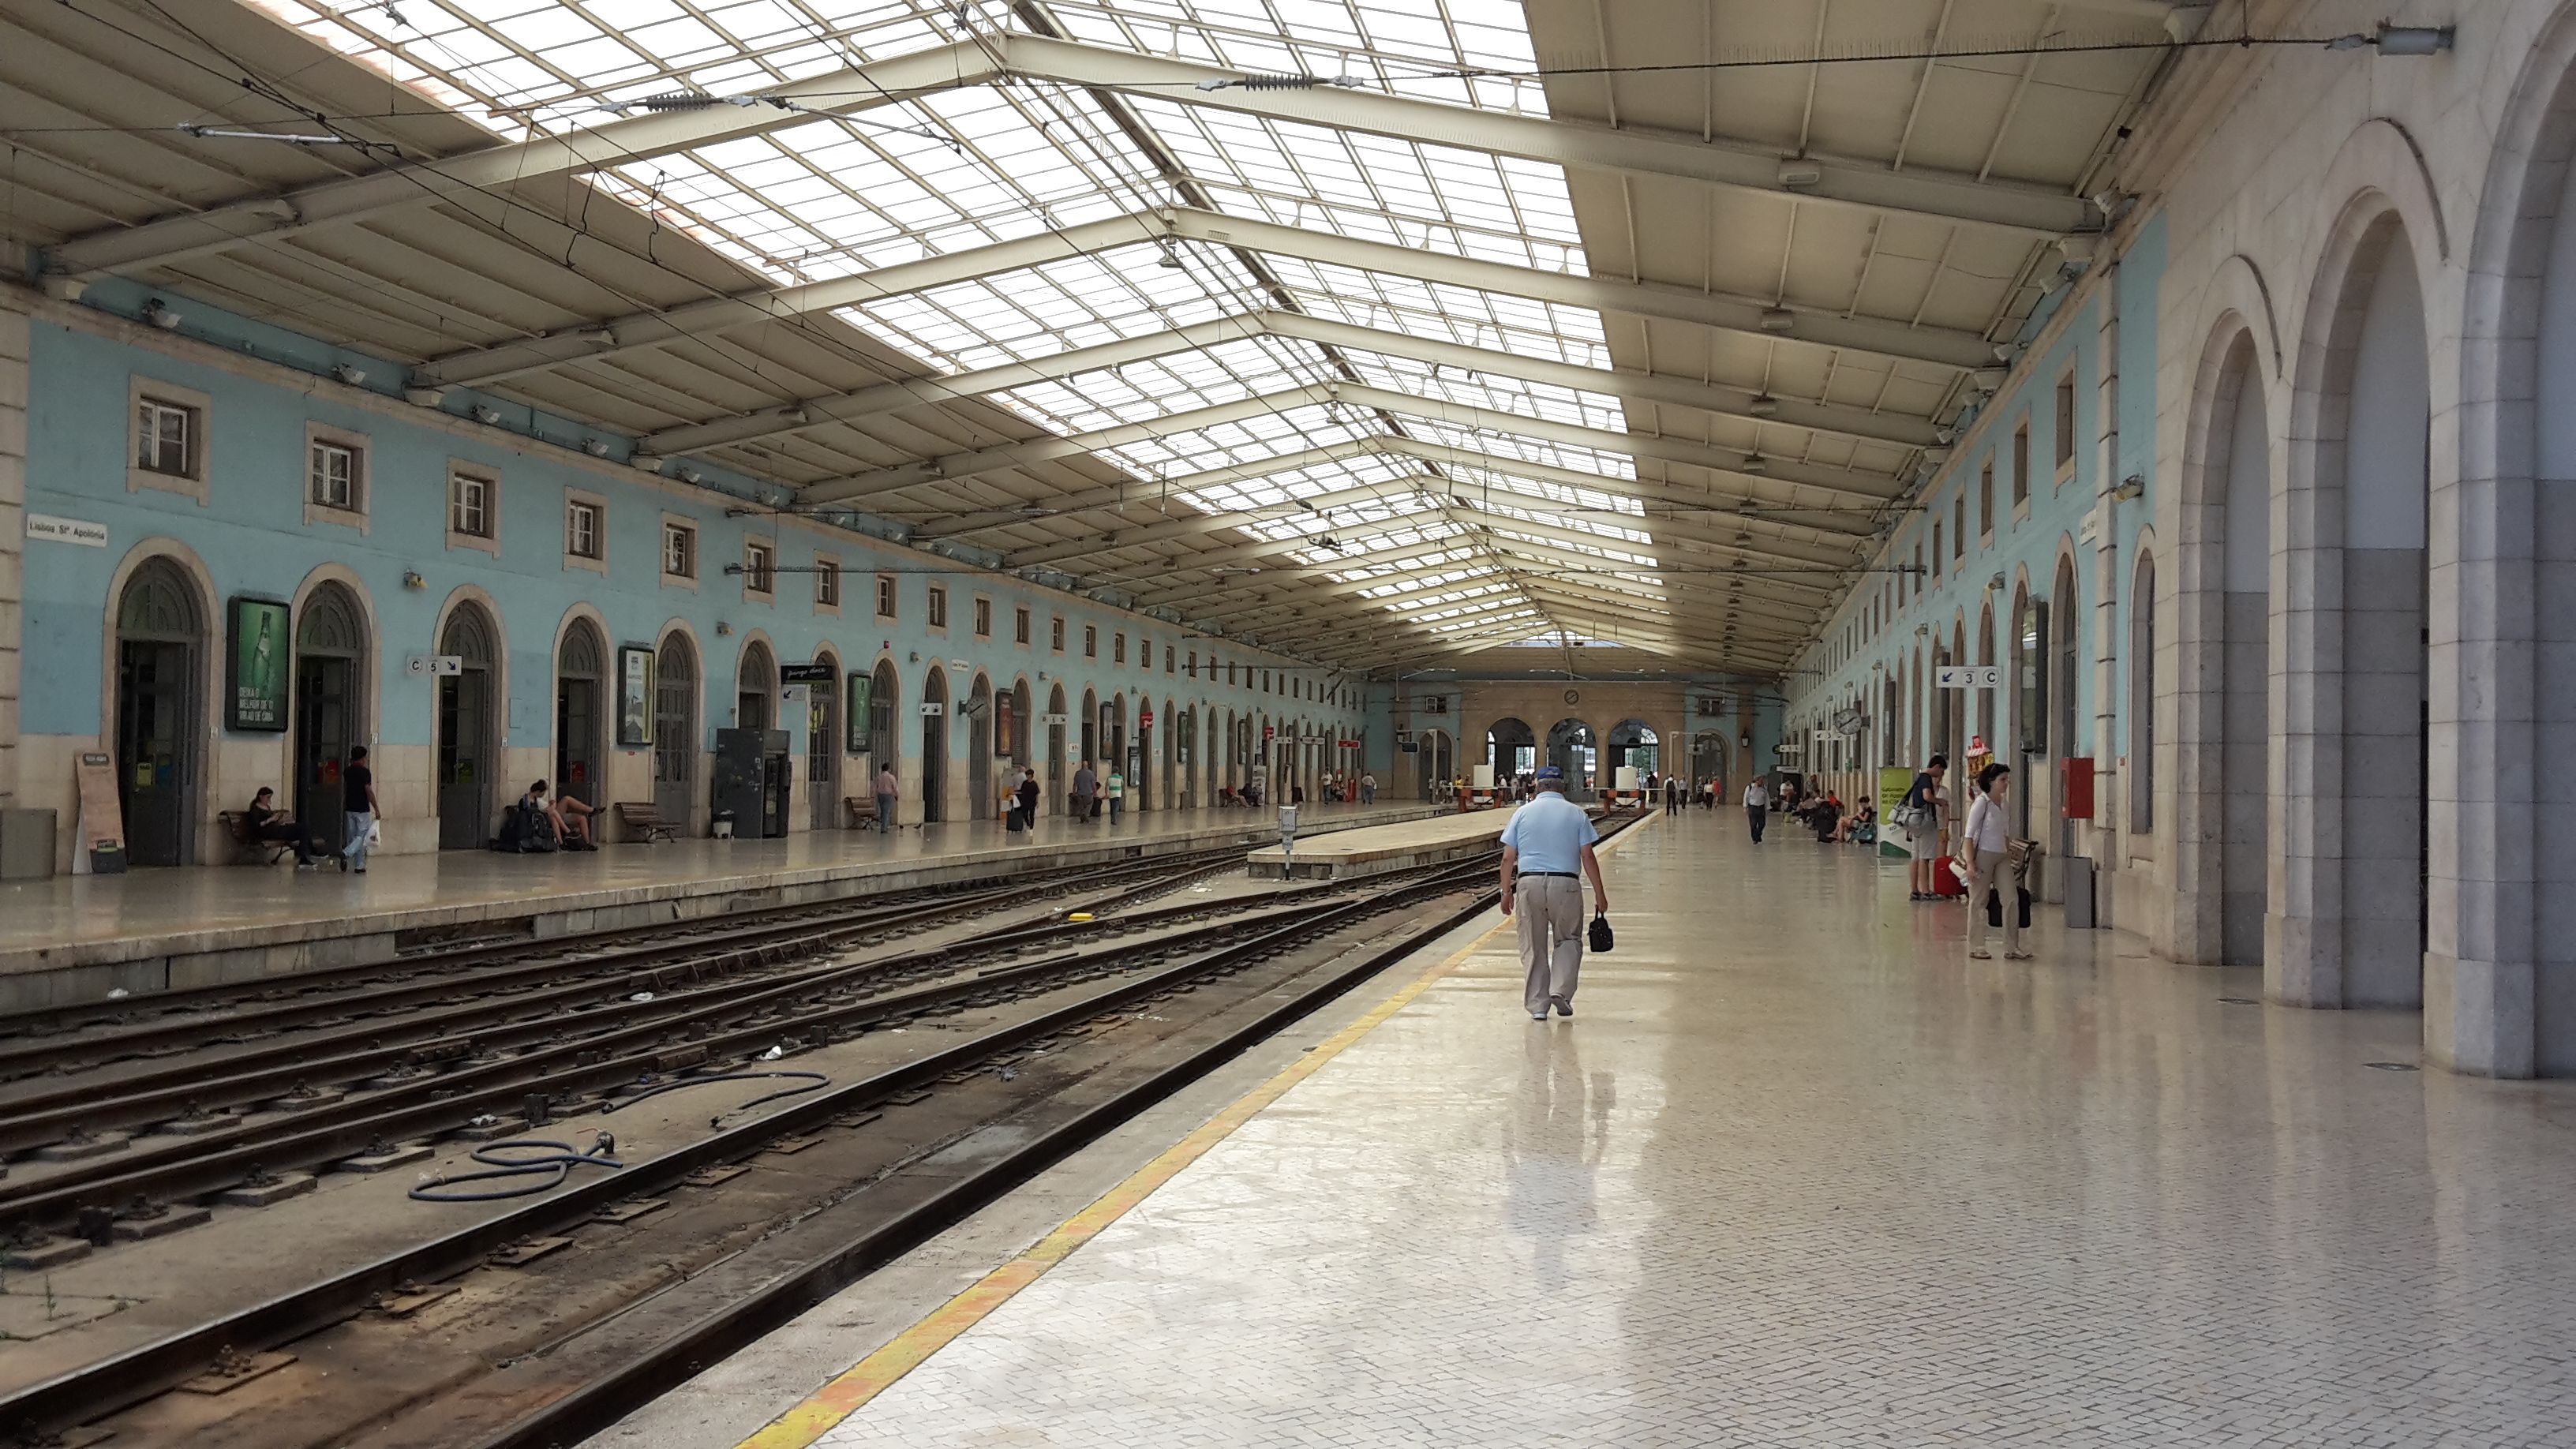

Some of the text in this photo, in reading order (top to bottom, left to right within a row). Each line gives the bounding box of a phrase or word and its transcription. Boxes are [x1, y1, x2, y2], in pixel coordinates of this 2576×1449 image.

[29, 522, 55, 533] Lisboa
[412, 661, 436, 672] C 5
[1965, 672, 1996, 683] 3 C
